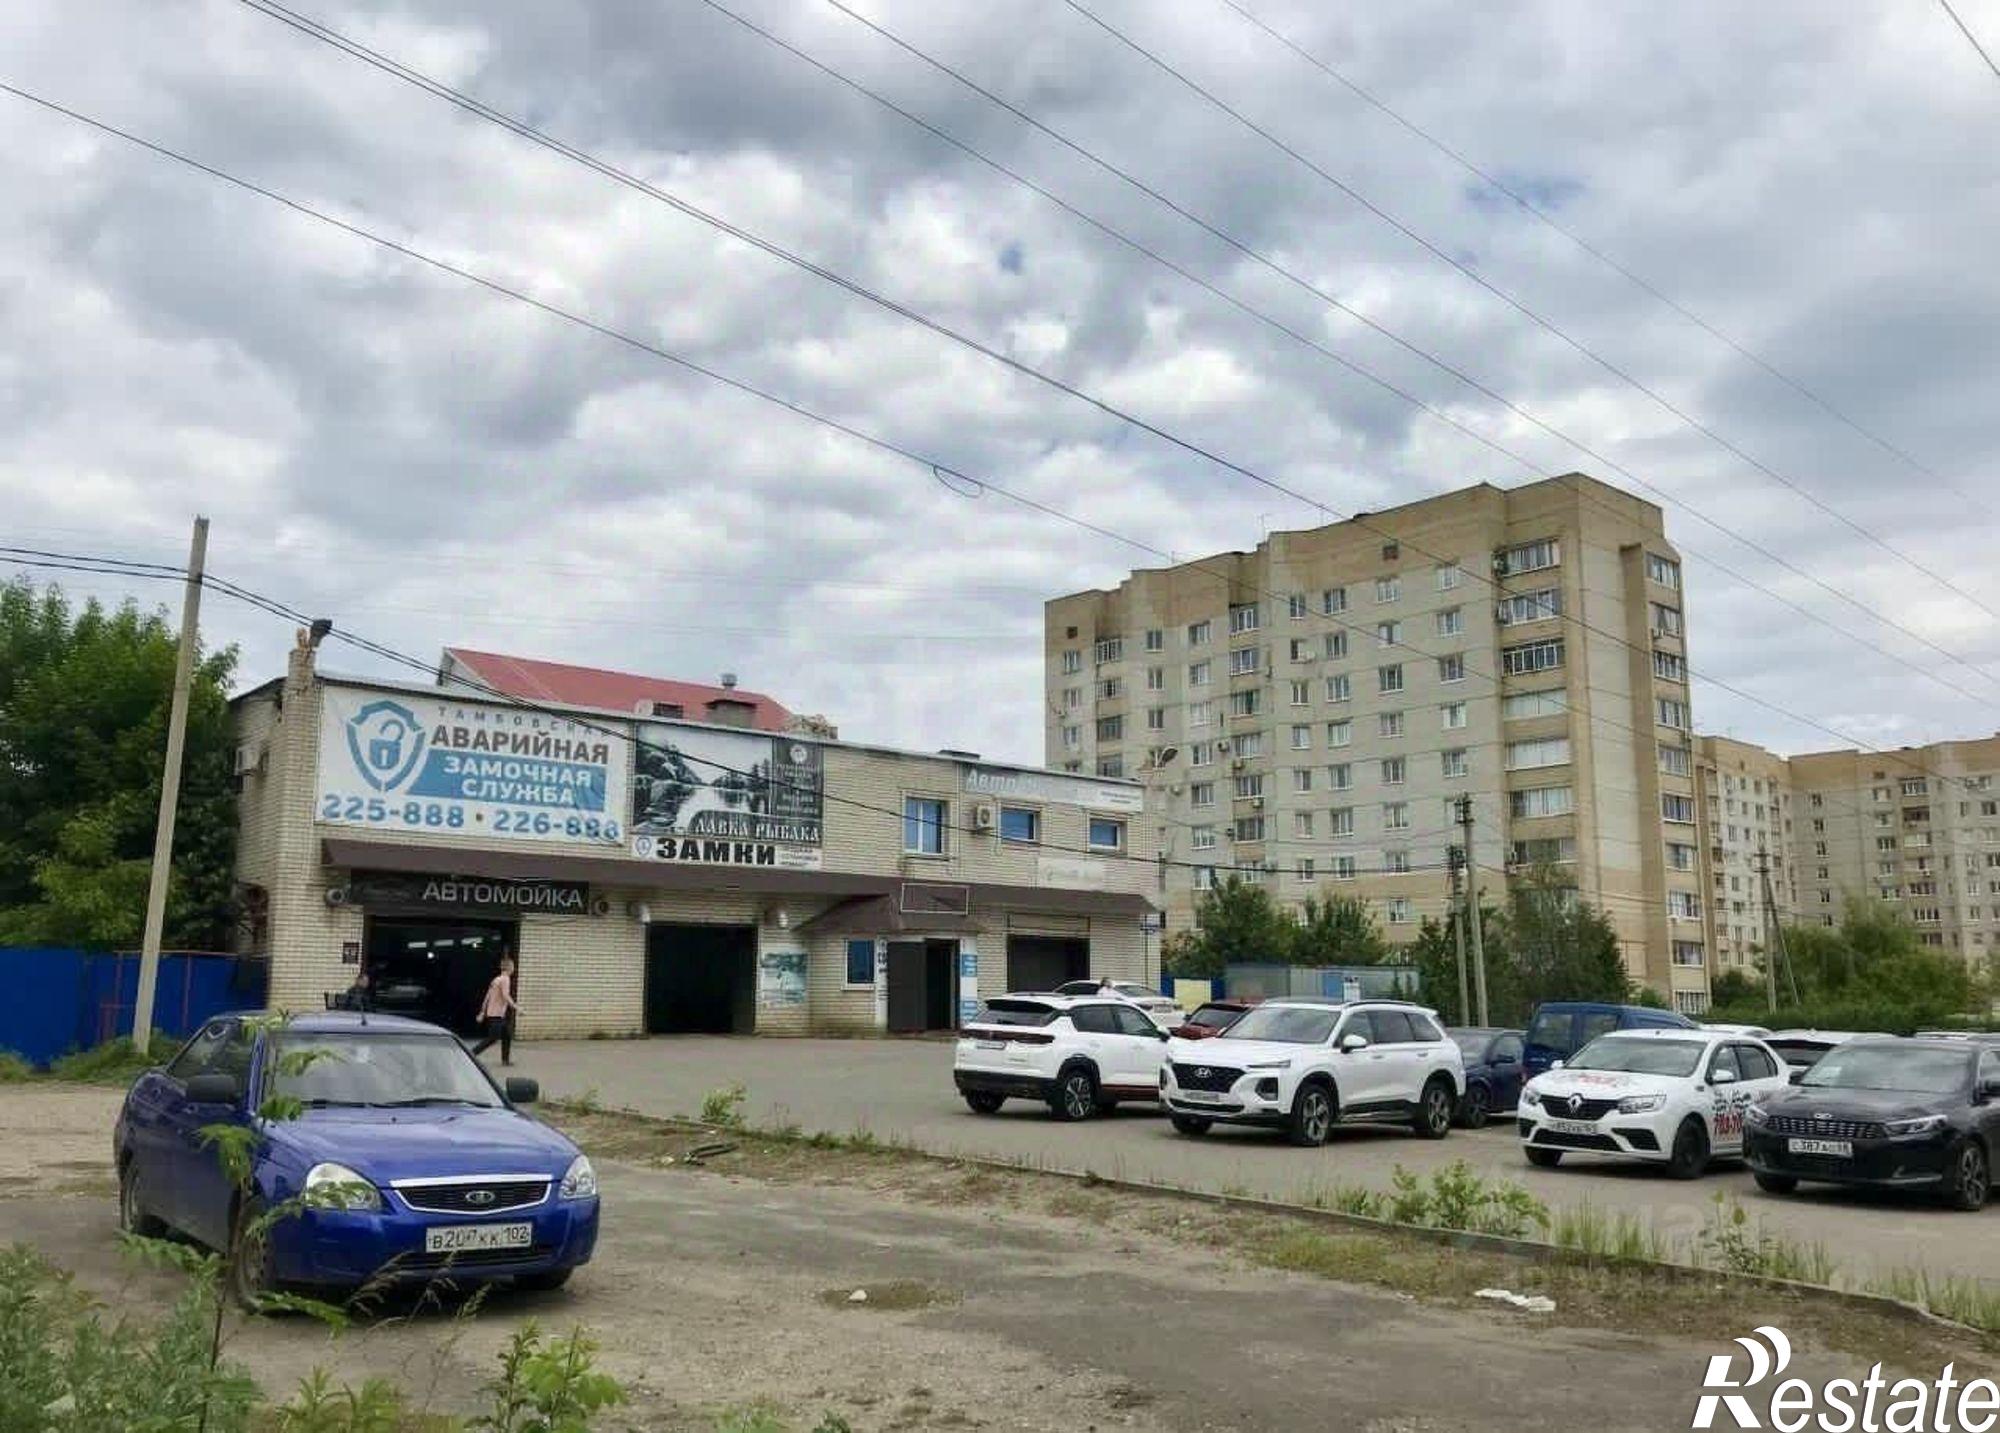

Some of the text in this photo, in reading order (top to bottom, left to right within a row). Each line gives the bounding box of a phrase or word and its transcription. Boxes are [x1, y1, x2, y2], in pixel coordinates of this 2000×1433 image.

[431, 724, 609, 765] АВАРИЙНАЯ
[444, 755, 592, 788] ЗАМОЧНАЯ
[462, 779, 575, 804] СЛУЖБА
[322, 793, 620, 841] 225-888 226-888
[656, 837, 776, 866] ЗАМКИ
[423, 881, 584, 908] АВТОМОЙКА
